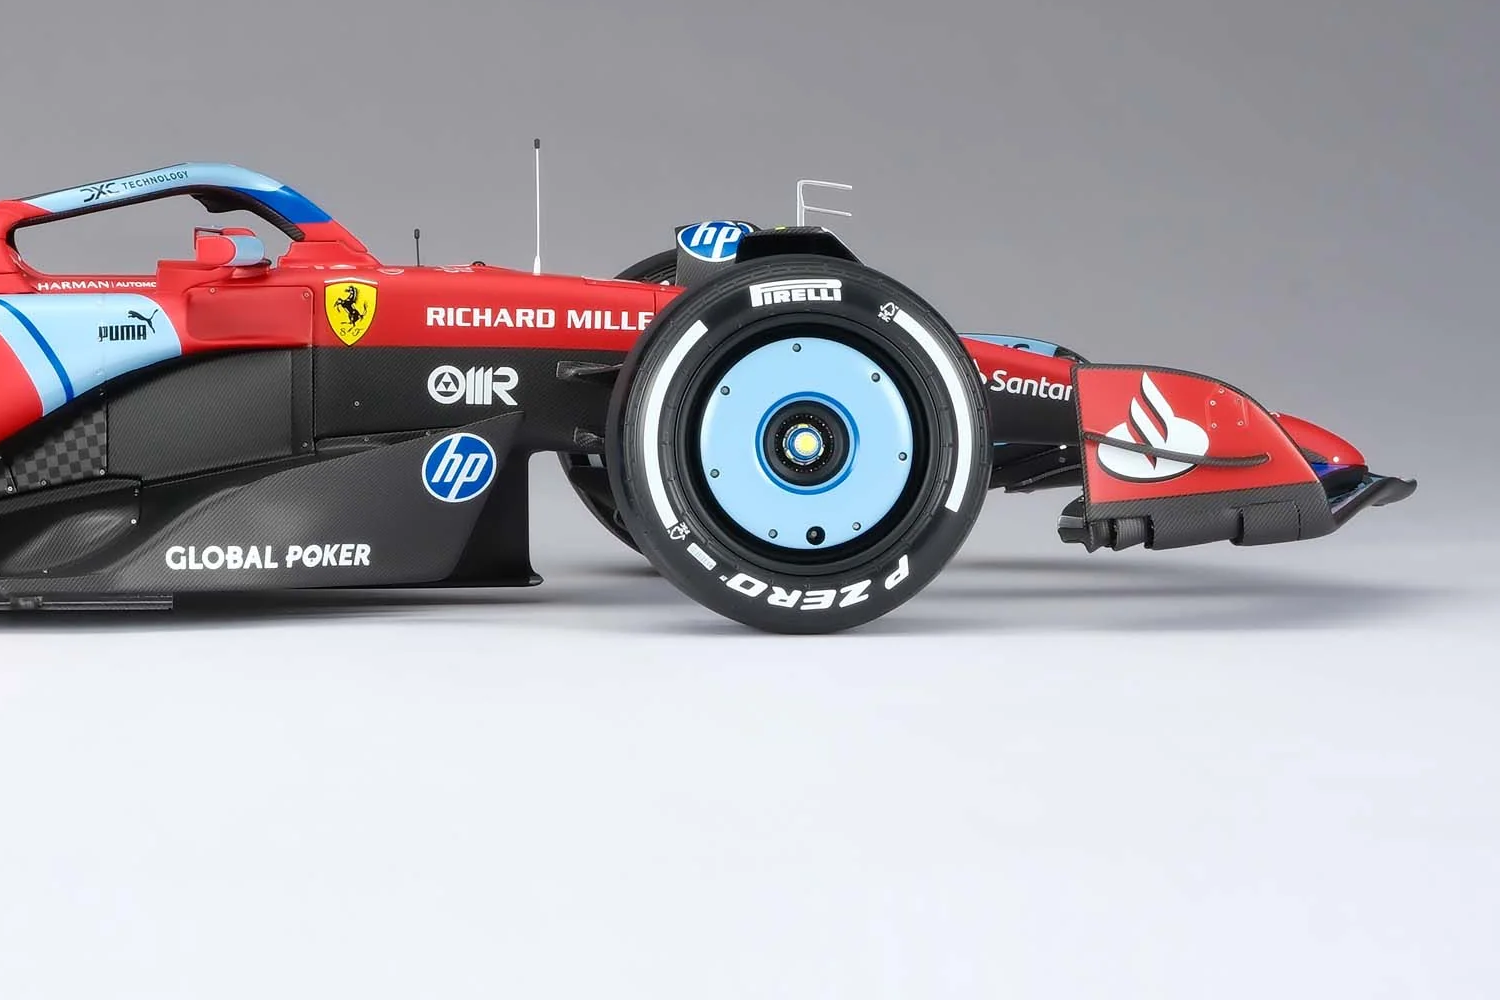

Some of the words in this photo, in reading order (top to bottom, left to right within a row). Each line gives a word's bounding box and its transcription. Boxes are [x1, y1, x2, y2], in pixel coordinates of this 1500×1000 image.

[122, 171, 189, 190] TECHNOLOGY
[690, 221, 741, 260] hp
[37, 280, 109, 291] HARMAN
[749, 279, 843, 308] PIRELLI
[426, 307, 556, 328] RICHARD
[98, 324, 147, 342] PUMA
[431, 434, 489, 501] hp
[165, 545, 278, 570] GLOBAL
[285, 543, 371, 568] POKER
[884, 554, 910, 590] P
[726, 572, 872, 611] ZERO
